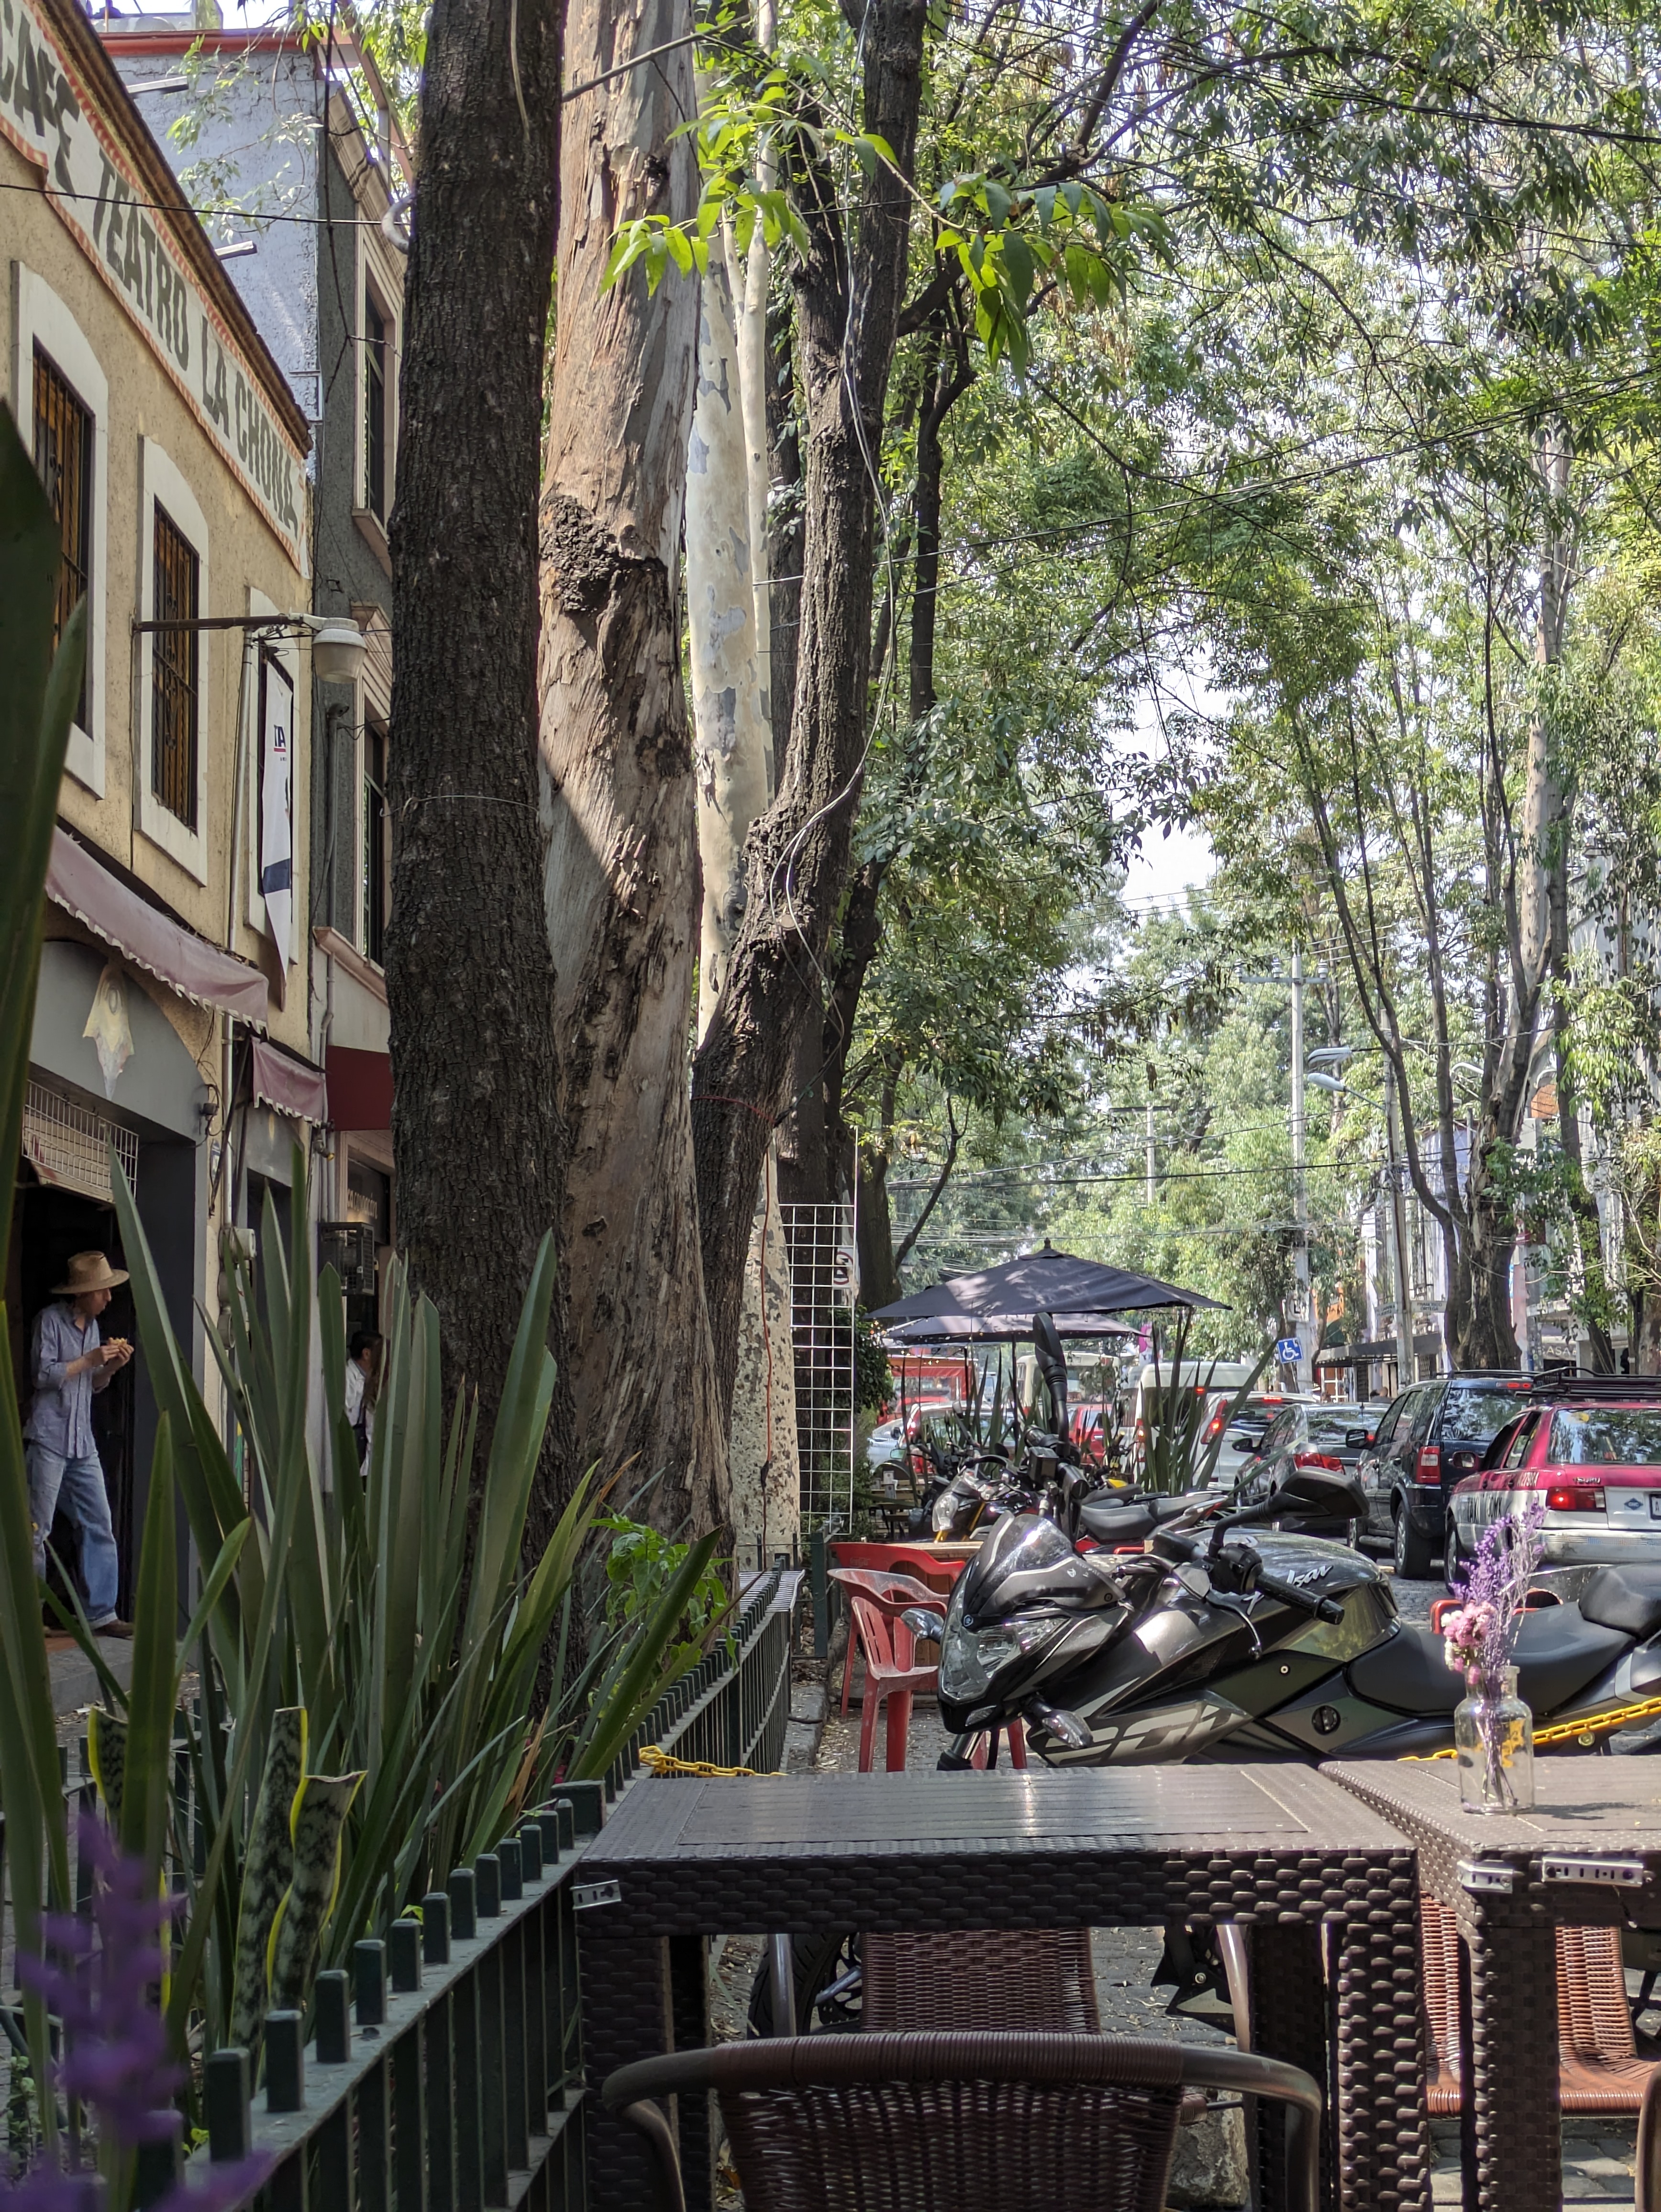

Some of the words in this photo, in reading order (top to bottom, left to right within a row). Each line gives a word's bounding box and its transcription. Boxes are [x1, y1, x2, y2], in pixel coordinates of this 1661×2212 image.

[92, 147, 189, 372] TEATRO
[201, 314, 230, 440] LA
[235, 370, 299, 541] CHONA
[1467, 1497, 1479, 1523] TAXI
